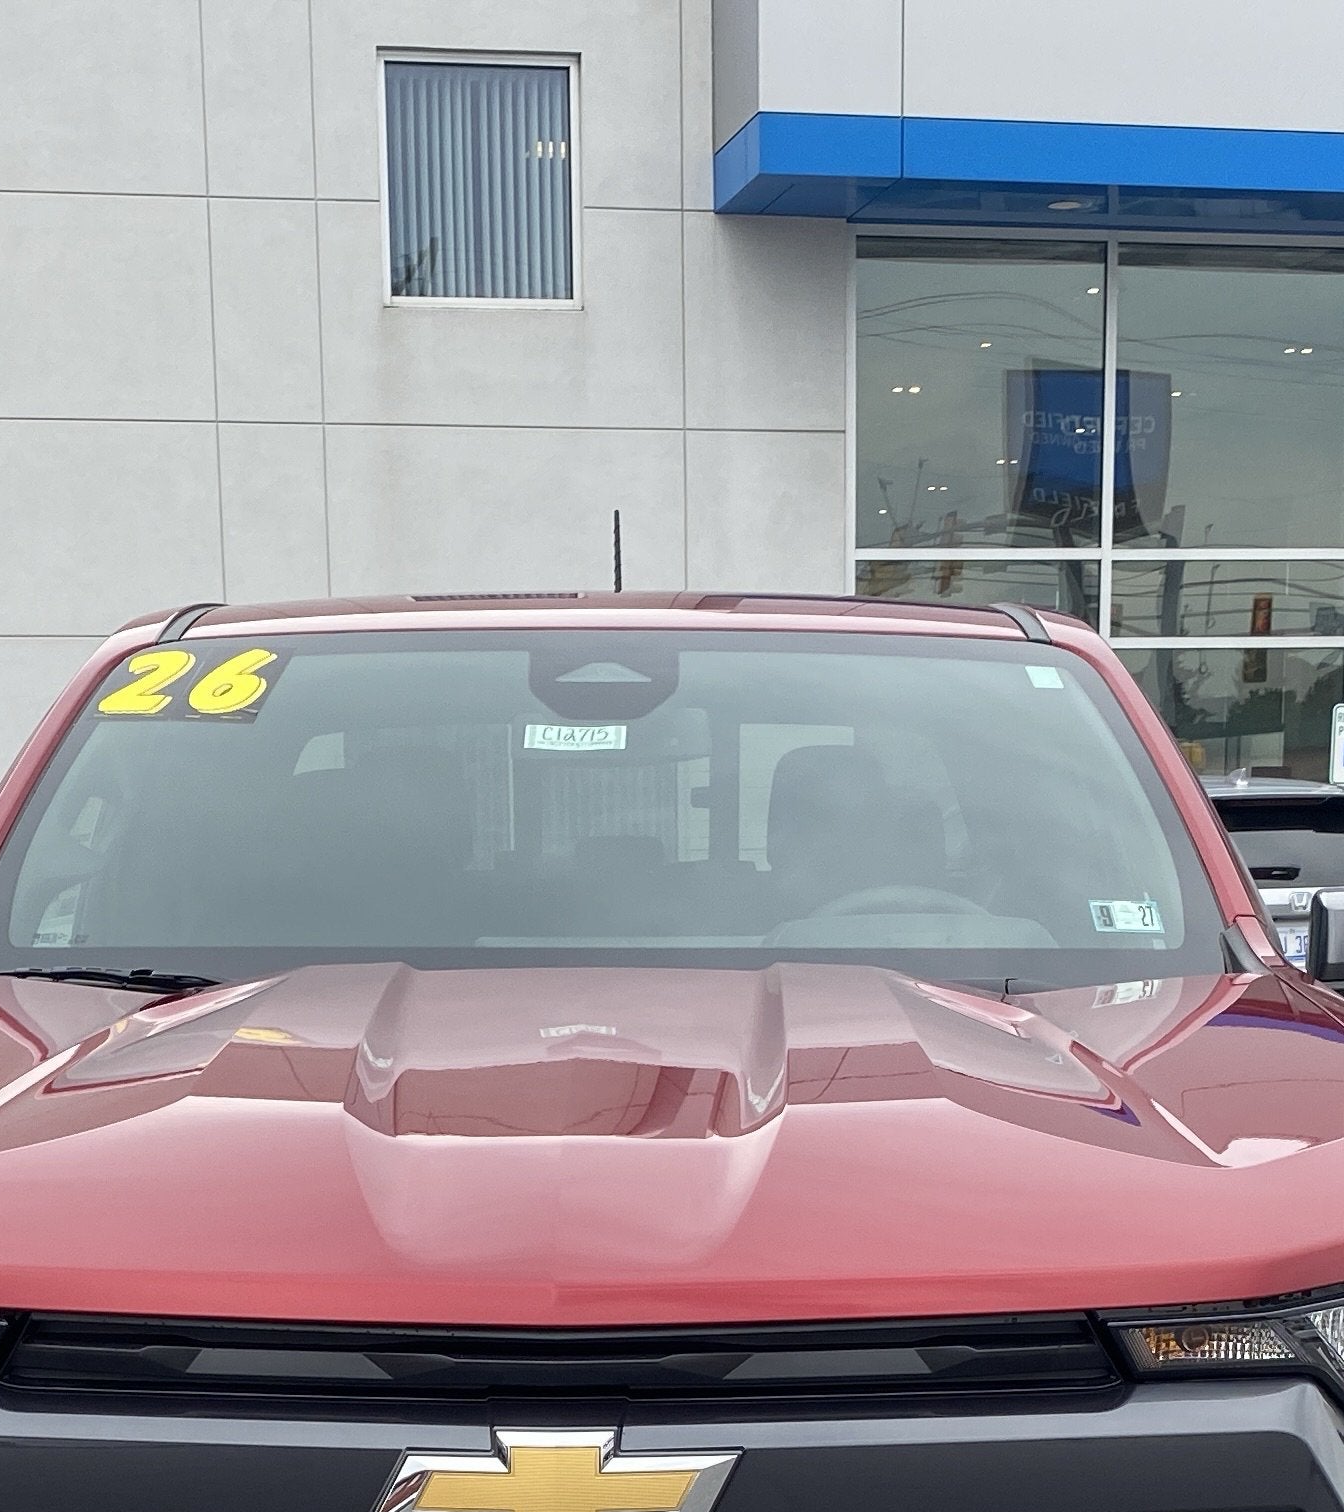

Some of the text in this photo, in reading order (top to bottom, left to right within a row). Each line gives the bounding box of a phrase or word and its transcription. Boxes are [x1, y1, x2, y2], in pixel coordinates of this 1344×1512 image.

[97, 647, 278, 715] 26
[542, 726, 609, 742] C12715
[1099, 905, 1154, 926] 9 27
